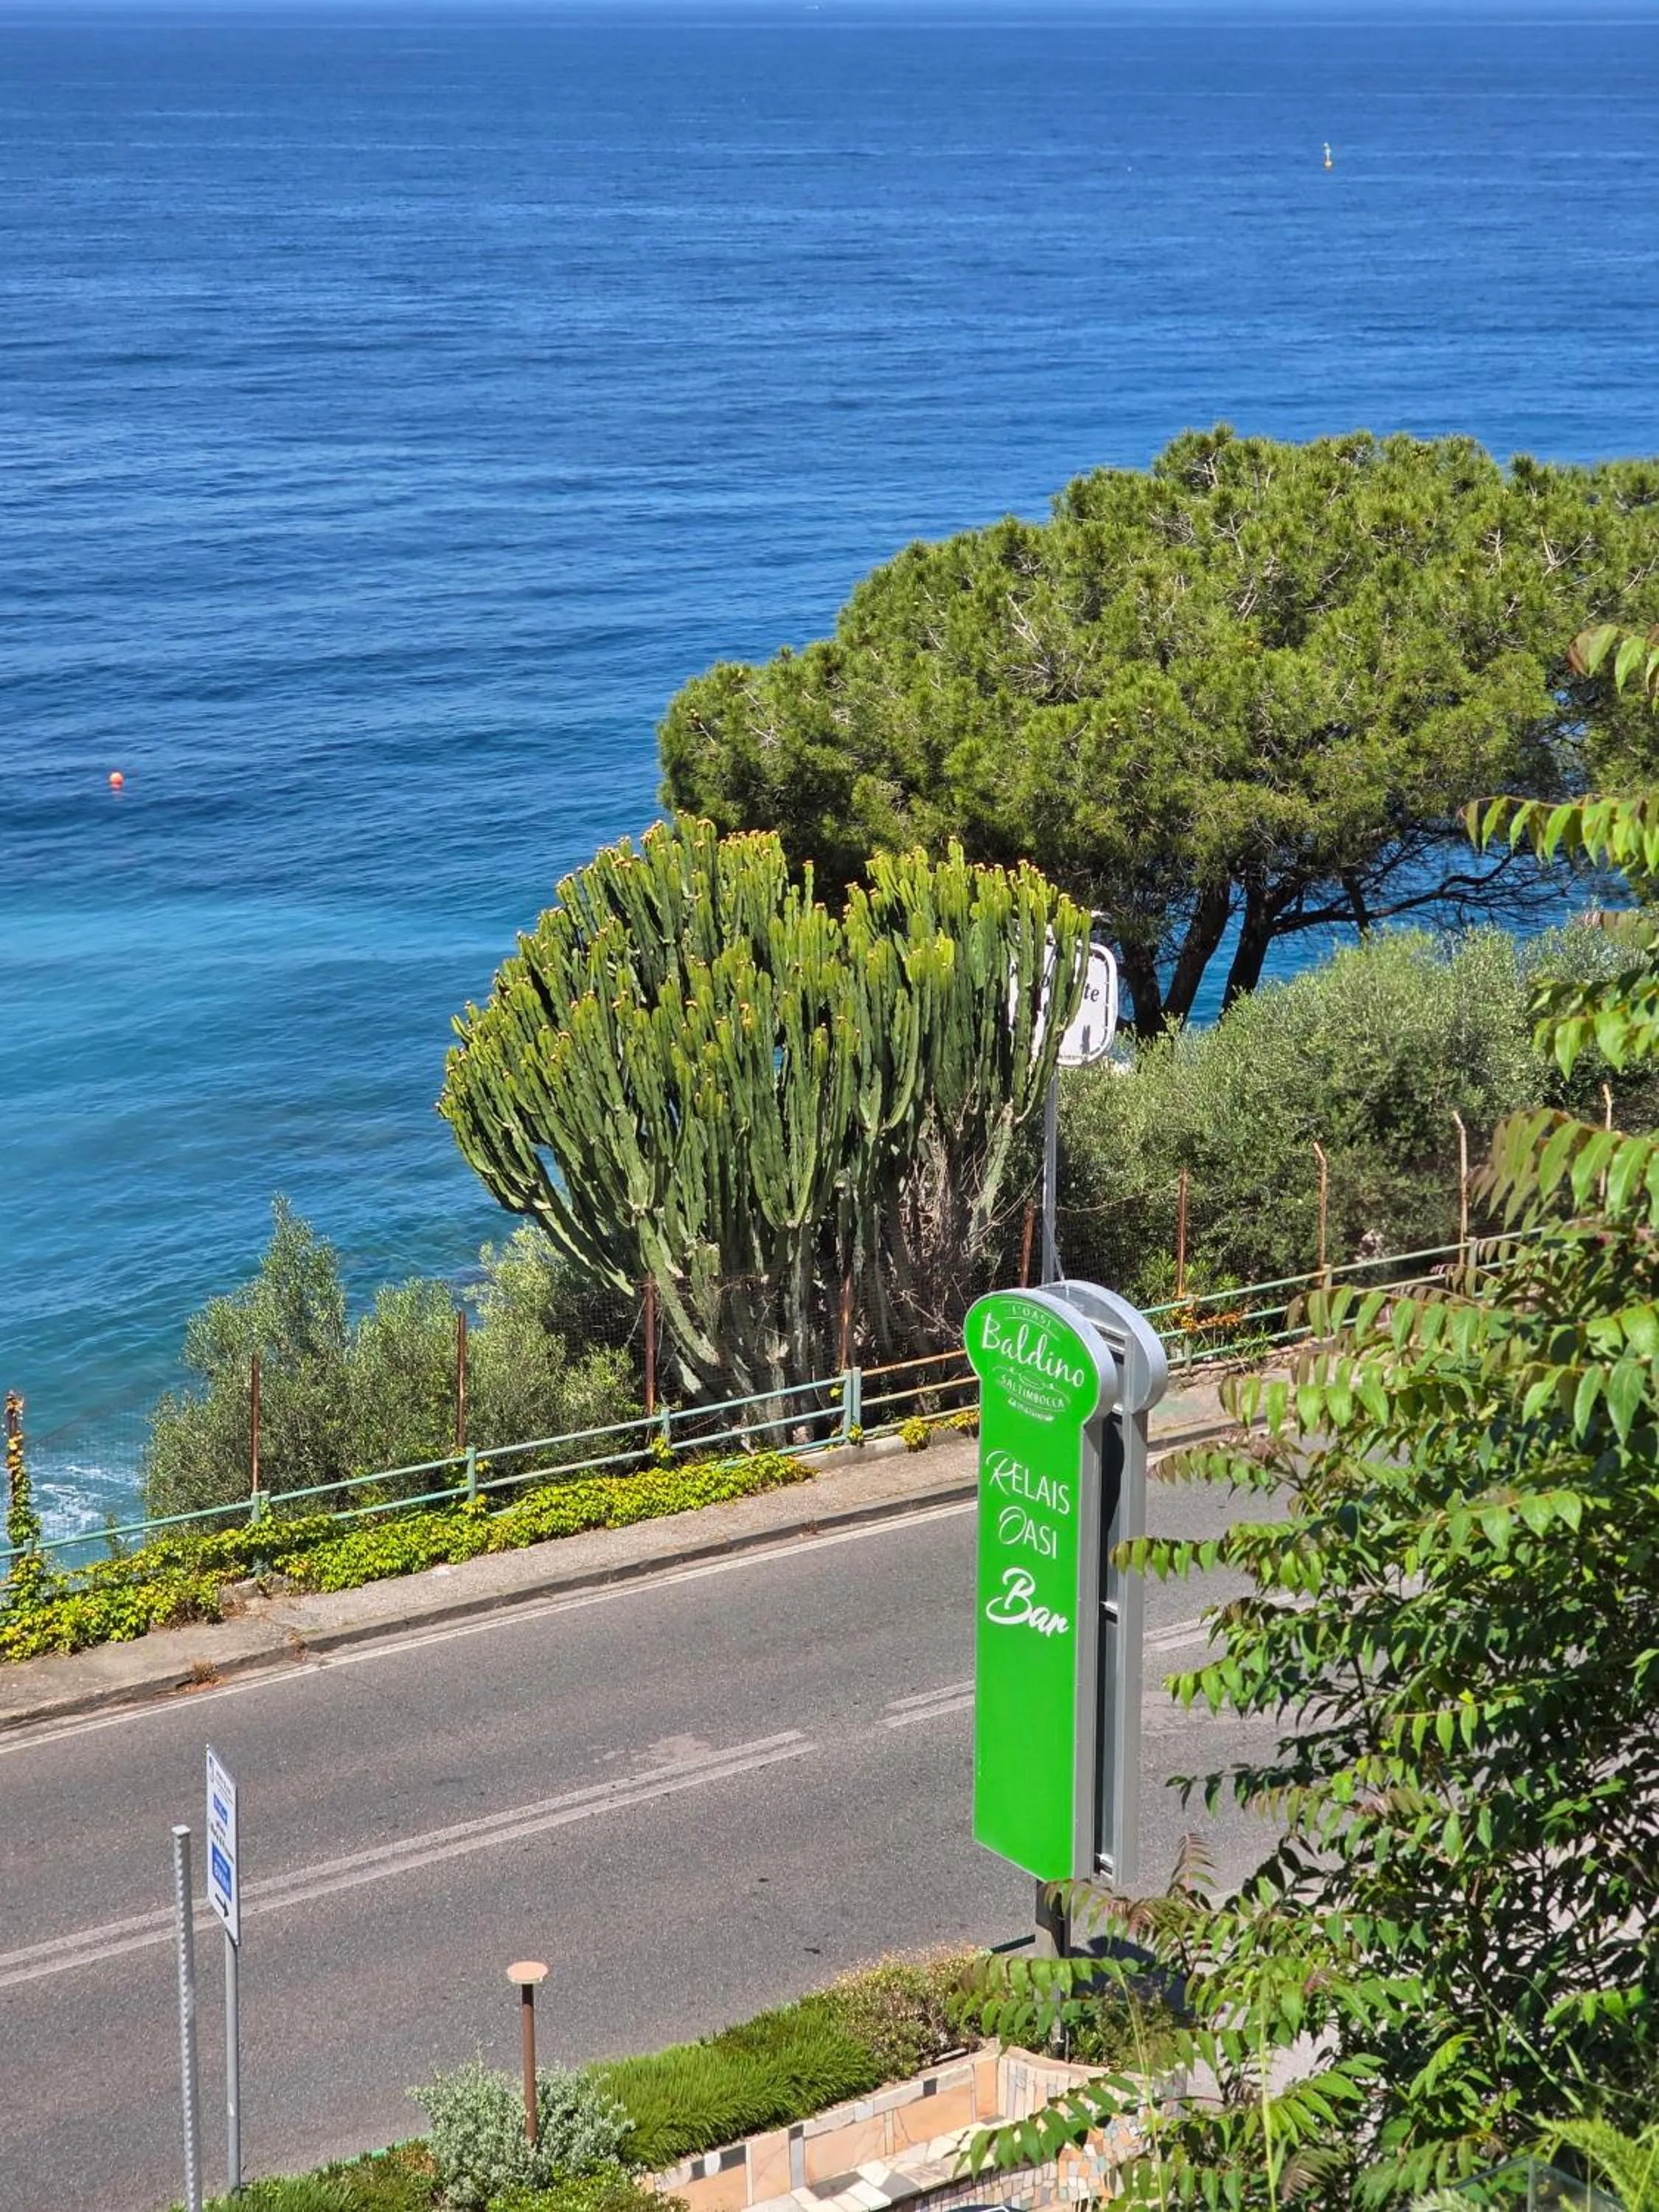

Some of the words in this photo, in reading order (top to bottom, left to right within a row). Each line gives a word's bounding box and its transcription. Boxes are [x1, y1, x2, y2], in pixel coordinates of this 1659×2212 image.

[981, 1312, 1085, 1387] Baldino
[986, 1450, 1070, 1515] RELAIS
[999, 1506, 1057, 1559] OASI
[986, 1568, 1069, 1638] Bar
